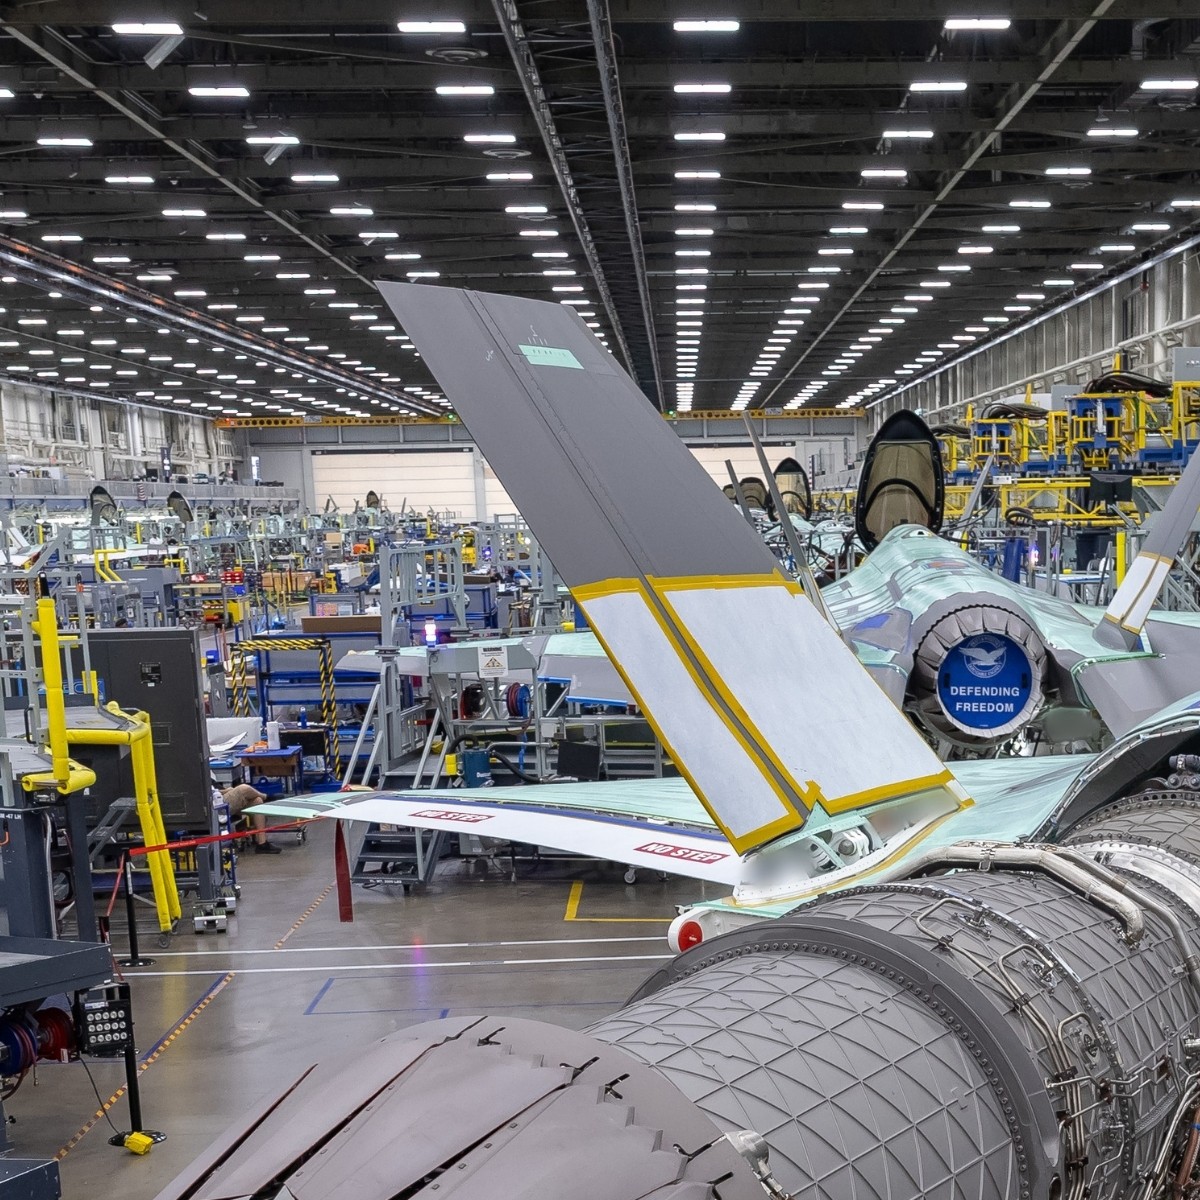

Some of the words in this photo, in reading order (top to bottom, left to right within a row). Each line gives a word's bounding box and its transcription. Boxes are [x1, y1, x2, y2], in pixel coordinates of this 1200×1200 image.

[950, 686, 1020, 697] DEFENDING
[956, 702, 1014, 713] FREEDOM
[417, 810, 441, 818] NO
[441, 812, 489, 823] STEP
[642, 843, 671, 854] NO
[671, 849, 723, 862] STEP
